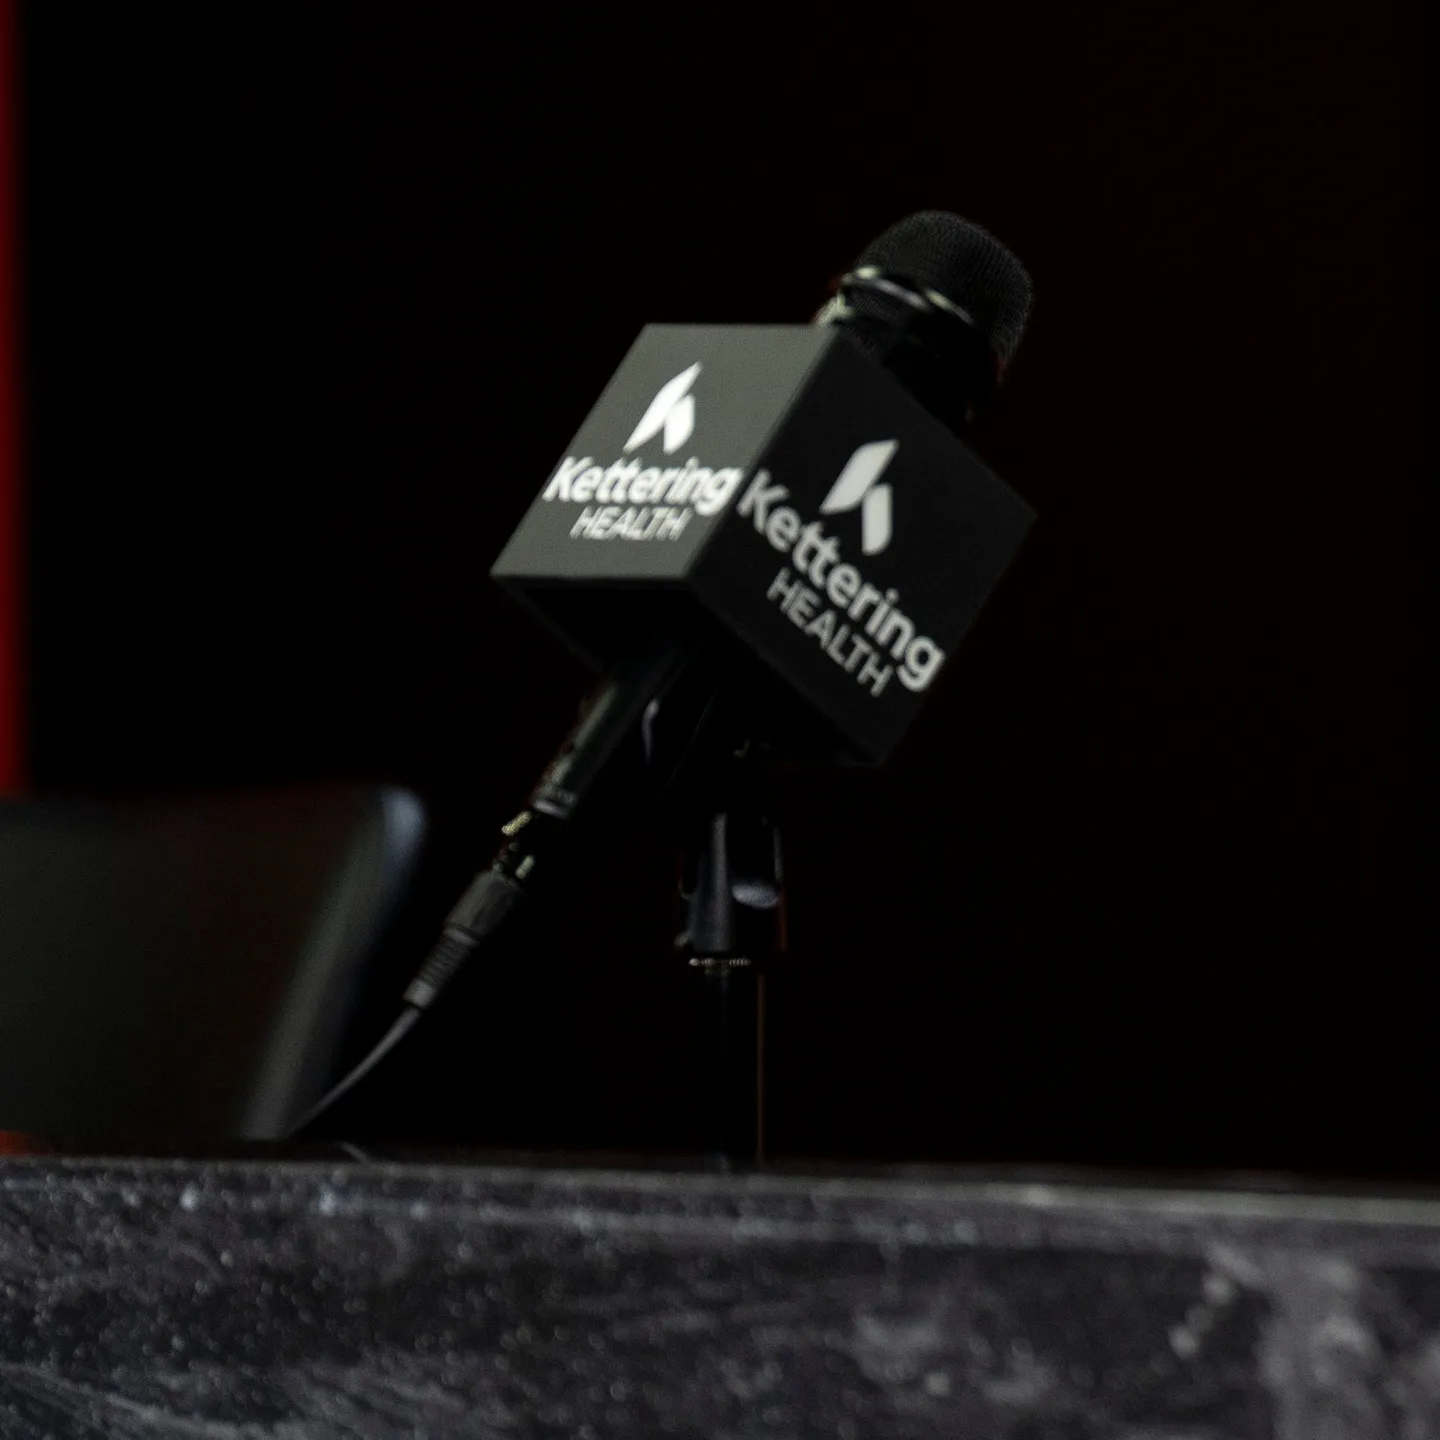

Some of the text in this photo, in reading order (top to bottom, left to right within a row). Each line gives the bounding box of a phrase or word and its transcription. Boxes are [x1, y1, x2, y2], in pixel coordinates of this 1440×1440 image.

[544, 456, 742, 515] Kettering
[570, 506, 692, 540] HEALTH
[738, 469, 944, 692] Kettering
[767, 567, 892, 696] HEALTH
